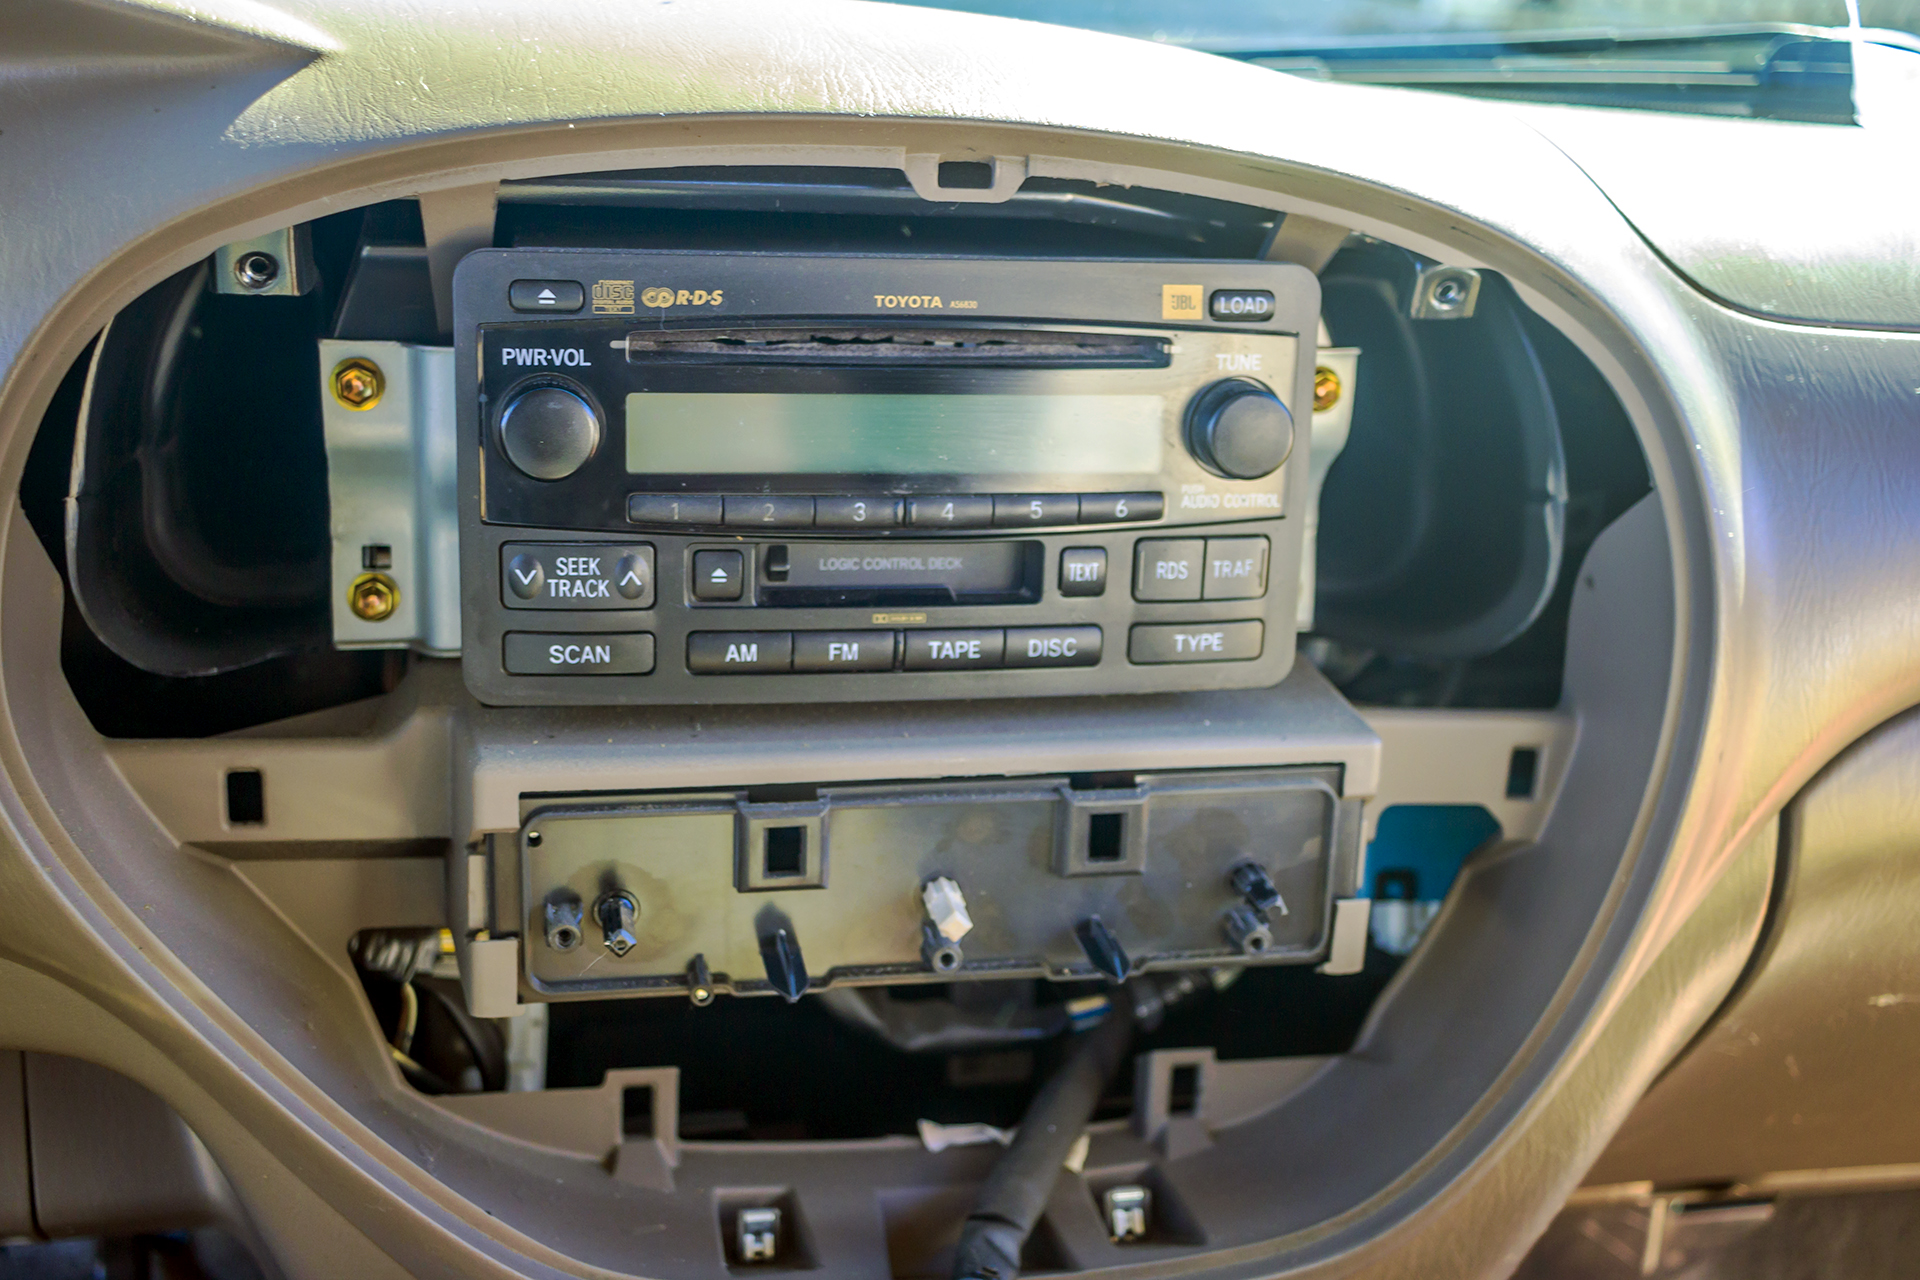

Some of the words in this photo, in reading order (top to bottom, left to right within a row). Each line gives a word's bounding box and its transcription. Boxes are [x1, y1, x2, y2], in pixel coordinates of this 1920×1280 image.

[874, 295, 943, 308] TOYOTA
[1219, 296, 1268, 314] LOAD
[1215, 353, 1263, 371] TUNE
[1029, 500, 1043, 520] 5
[1115, 499, 1129, 518] 6
[1180, 494, 1220, 509] AUDIO
[1223, 493, 1280, 508] CONTROL
[670, 503, 680, 520] 1
[763, 503, 776, 521] 2
[852, 502, 867, 521] 3
[941, 502, 955, 521] 4
[555, 557, 601, 577] SEEK
[819, 558, 860, 571] LOGIC
[862, 557, 926, 571] CONTROL
[928, 557, 963, 570] DECK
[1068, 561, 1100, 582] TEXT
[1155, 561, 1189, 580] RDS
[1212, 560, 1256, 578] TRAF
[546, 578, 610, 598] TRACK
[828, 642, 859, 662] FM
[928, 640, 981, 660] TAPE
[1027, 638, 1078, 658] DISC
[1174, 633, 1224, 653] TYPE
[548, 644, 611, 664] SCAN
[725, 643, 758, 663] AM
